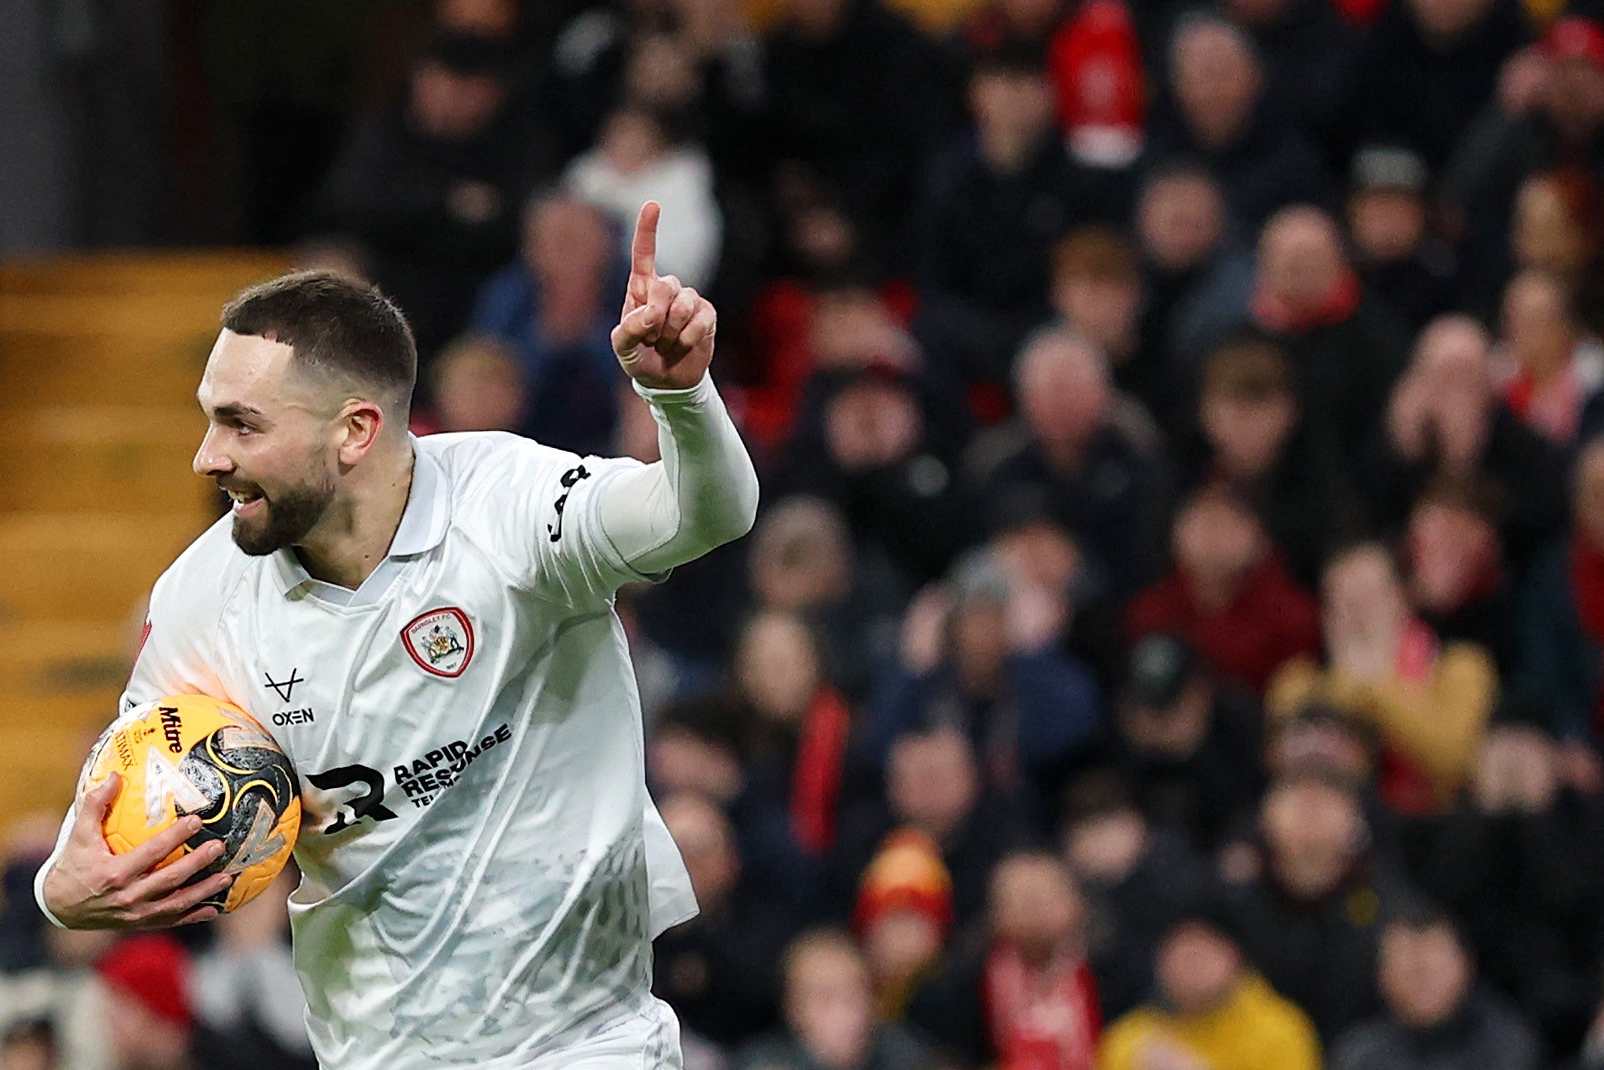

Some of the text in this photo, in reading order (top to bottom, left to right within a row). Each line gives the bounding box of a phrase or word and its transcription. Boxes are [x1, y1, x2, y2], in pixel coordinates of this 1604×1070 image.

[158, 706, 183, 754] Mitre
[272, 708, 315, 726] OXEN
[393, 740, 468, 785] RAPID
[401, 723, 512, 798] RESNSE
